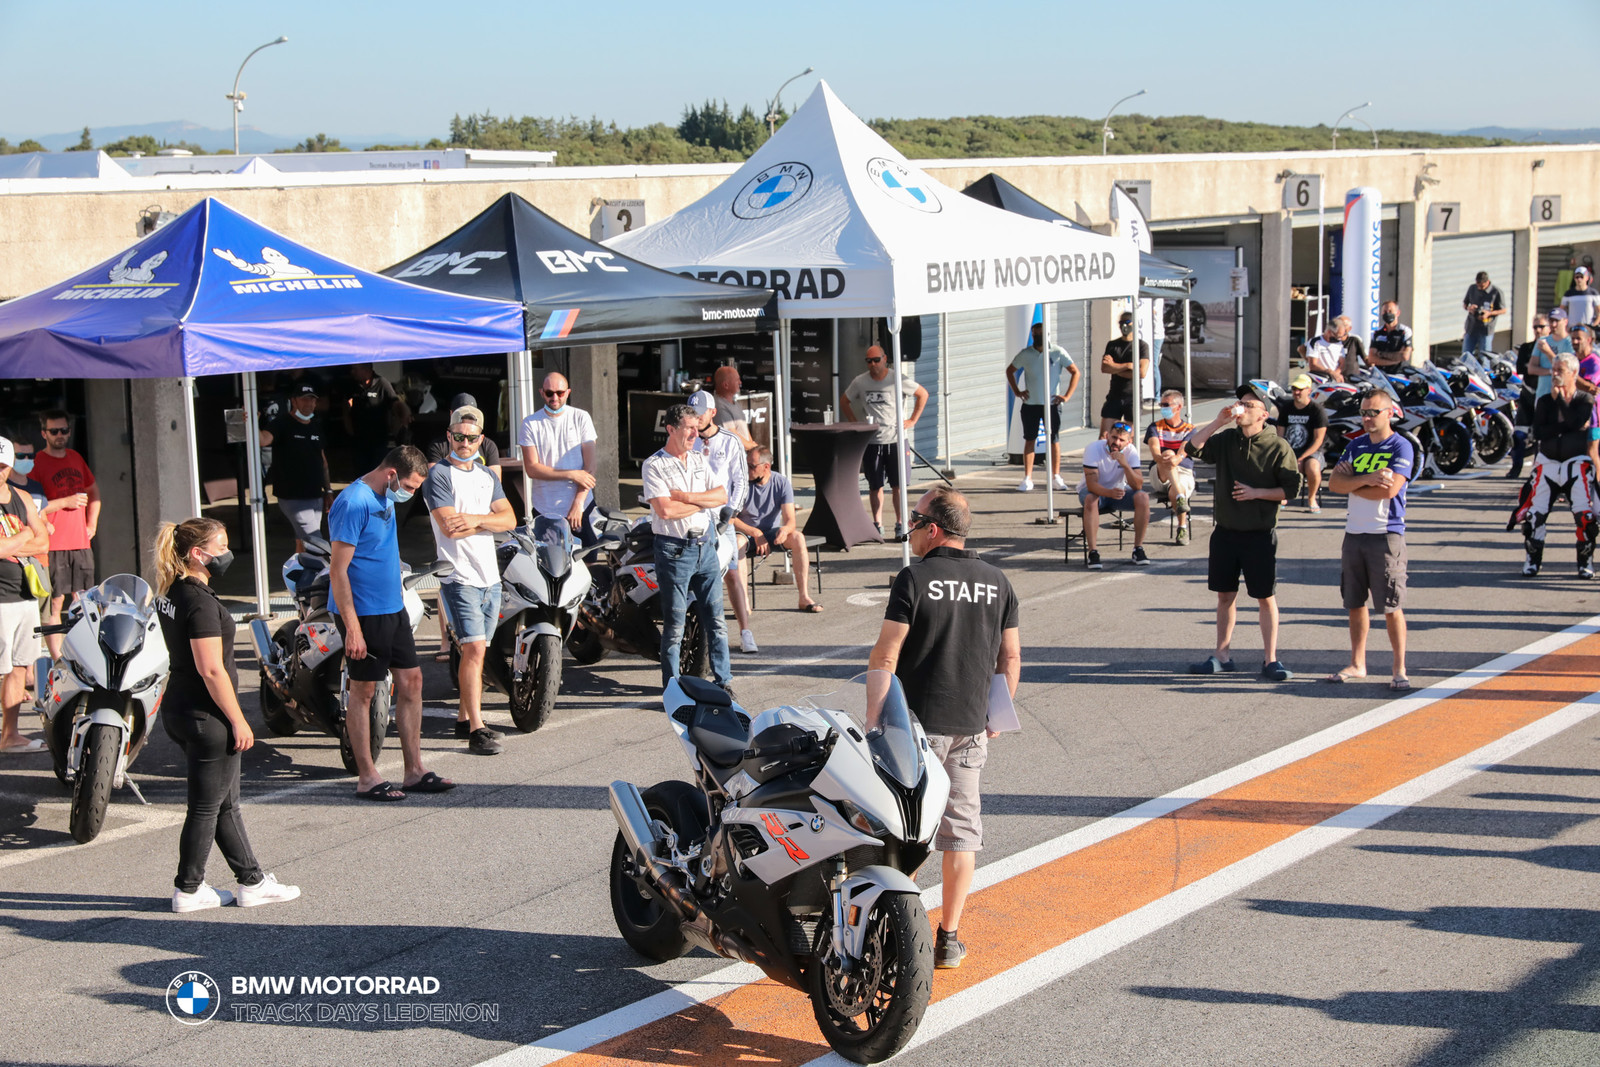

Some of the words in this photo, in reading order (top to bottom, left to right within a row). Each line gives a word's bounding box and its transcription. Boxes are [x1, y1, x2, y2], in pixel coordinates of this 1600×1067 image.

[1296, 180, 1310, 206] 6
[1440, 208, 1453, 230] 7
[1541, 199, 1553, 220] 8
[393, 251, 507, 278] BMC
[535, 250, 628, 274] BMC
[926, 260, 986, 293] BMW
[994, 252, 1115, 288] MOTORRAD
[231, 279, 363, 294] MICHELIN
[1370, 220, 1381, 332] RACKDAYS
[51, 287, 171, 301] MICHELIN
[702, 308, 765, 321] bmc-moto.com
[454, 365, 503, 376] MICHELIN
[743, 407, 767, 424] MC
[1353, 453, 1392, 473] 46
[928, 580, 998, 605] STAFF
[156, 597, 176, 620] TEAM
